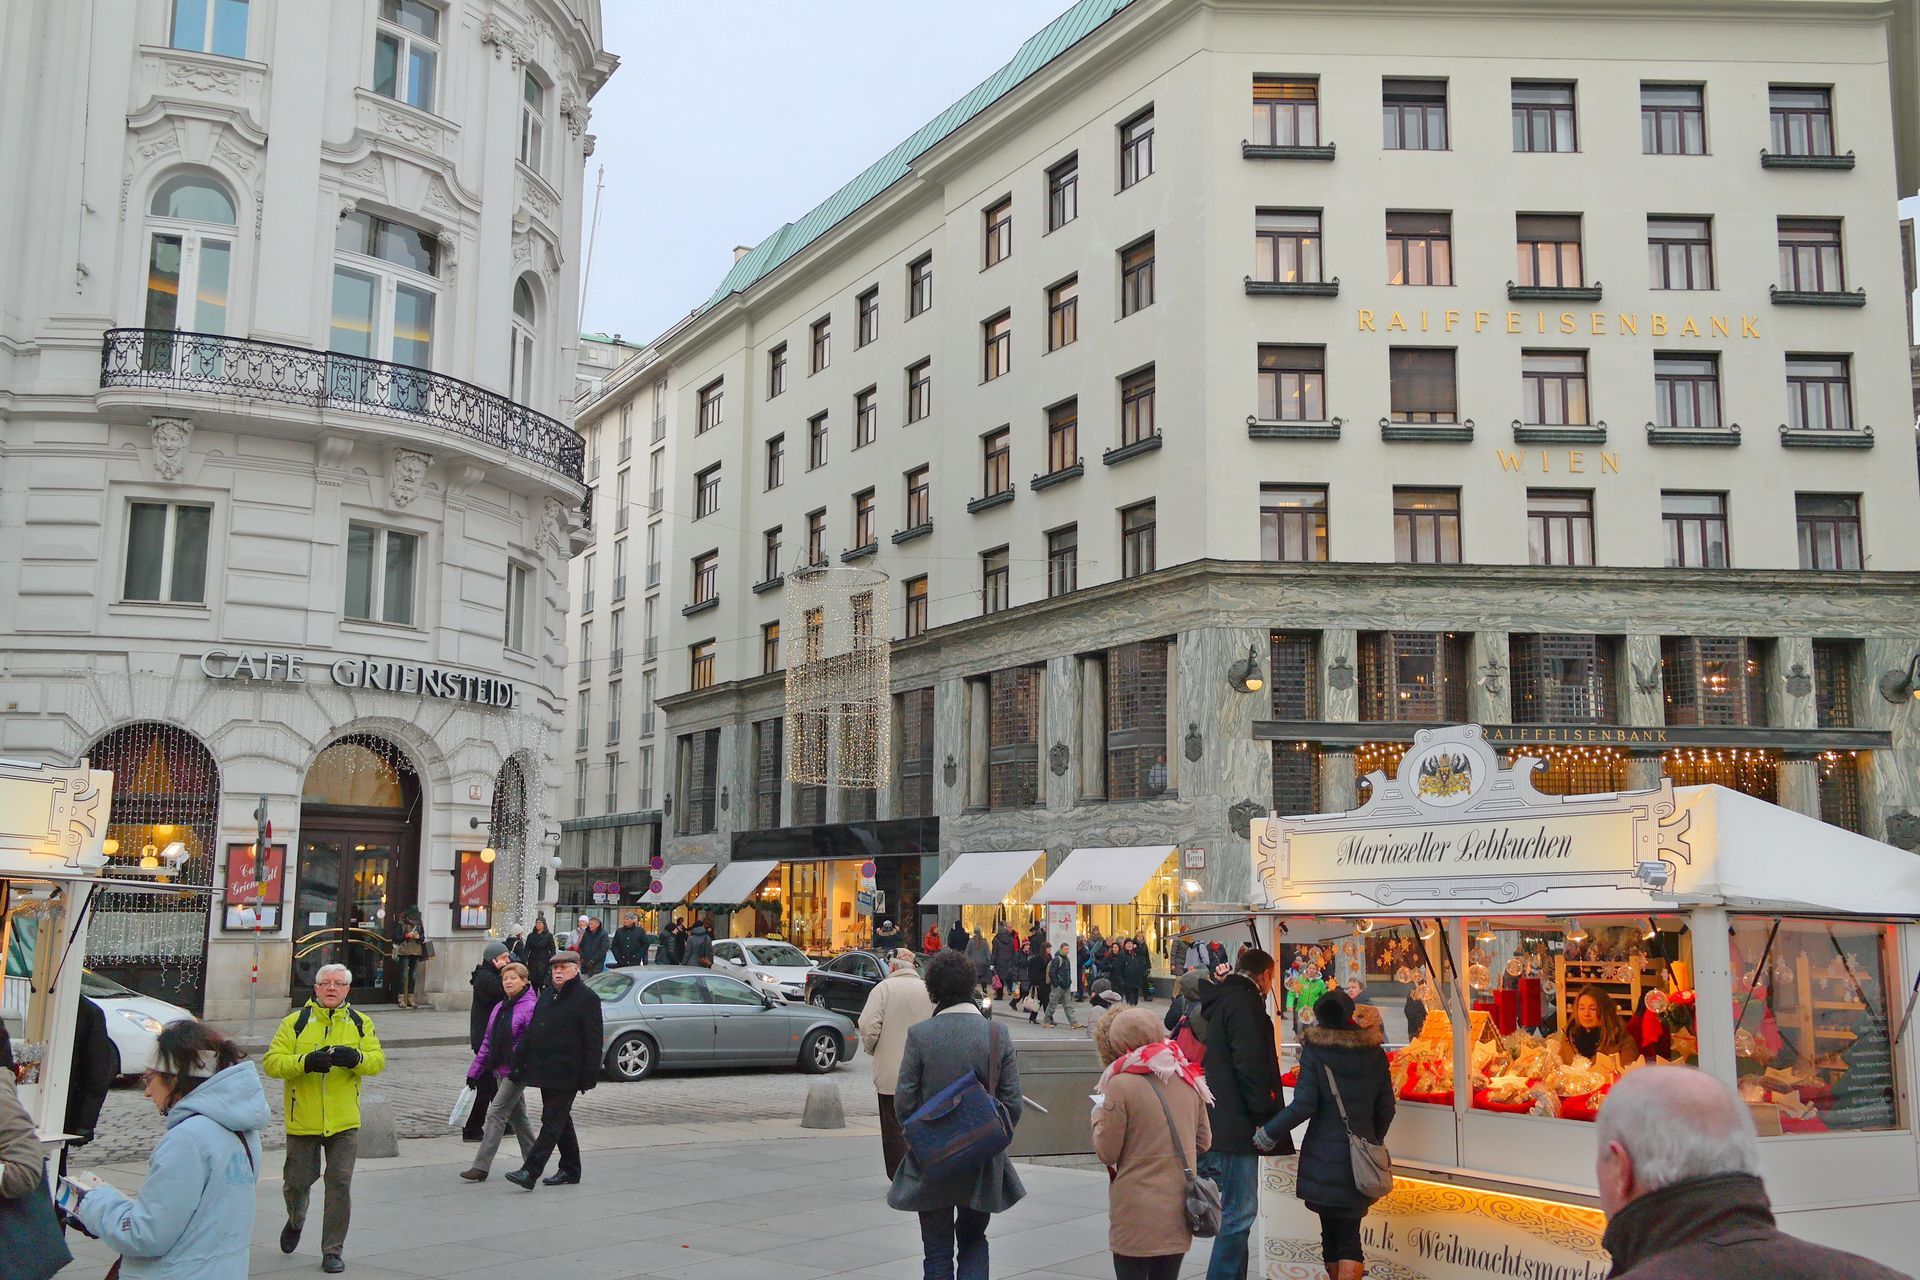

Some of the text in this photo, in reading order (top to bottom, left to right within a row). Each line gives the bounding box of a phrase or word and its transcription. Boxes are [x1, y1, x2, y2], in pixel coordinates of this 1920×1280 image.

[1358, 310, 1760, 338] RAIFFEISENBANK
[1496, 448, 1619, 474] WIEN
[200, 648, 521, 709] CAFE GRIENSTEIDL
[1482, 728, 1667, 742] RAIFFEISENBANK
[1337, 826, 1572, 866] Mariazeller Lebkuchen
[231, 865, 278, 896] Griensdl
